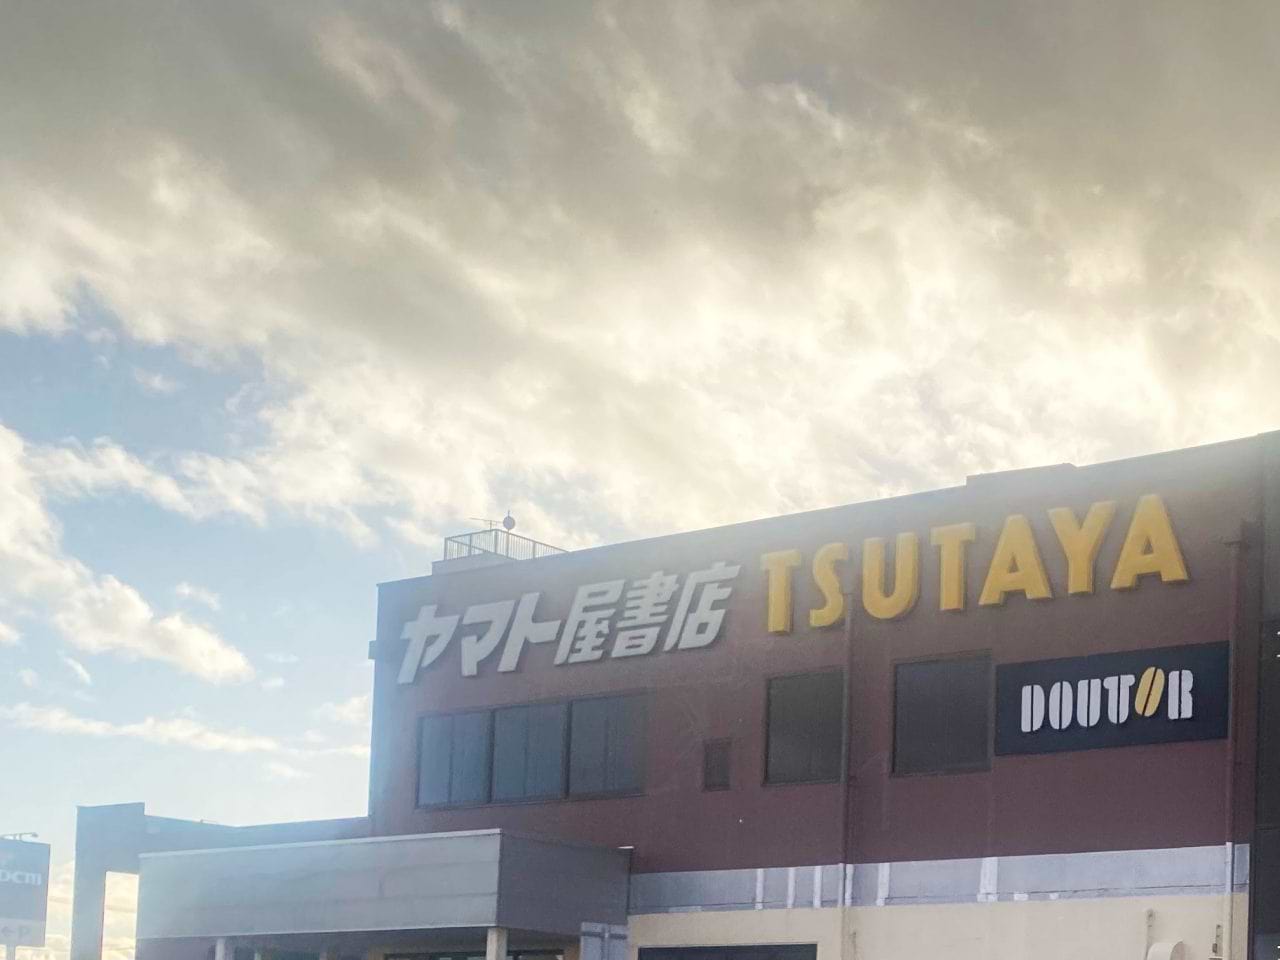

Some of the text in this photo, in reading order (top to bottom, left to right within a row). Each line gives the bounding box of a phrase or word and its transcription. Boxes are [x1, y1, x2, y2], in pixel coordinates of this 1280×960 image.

[396, 562, 741, 684] ヤマト屋書店
[760, 494, 1189, 634] TSUTAYA
[1021, 666, 1194, 732] DOUTOR
